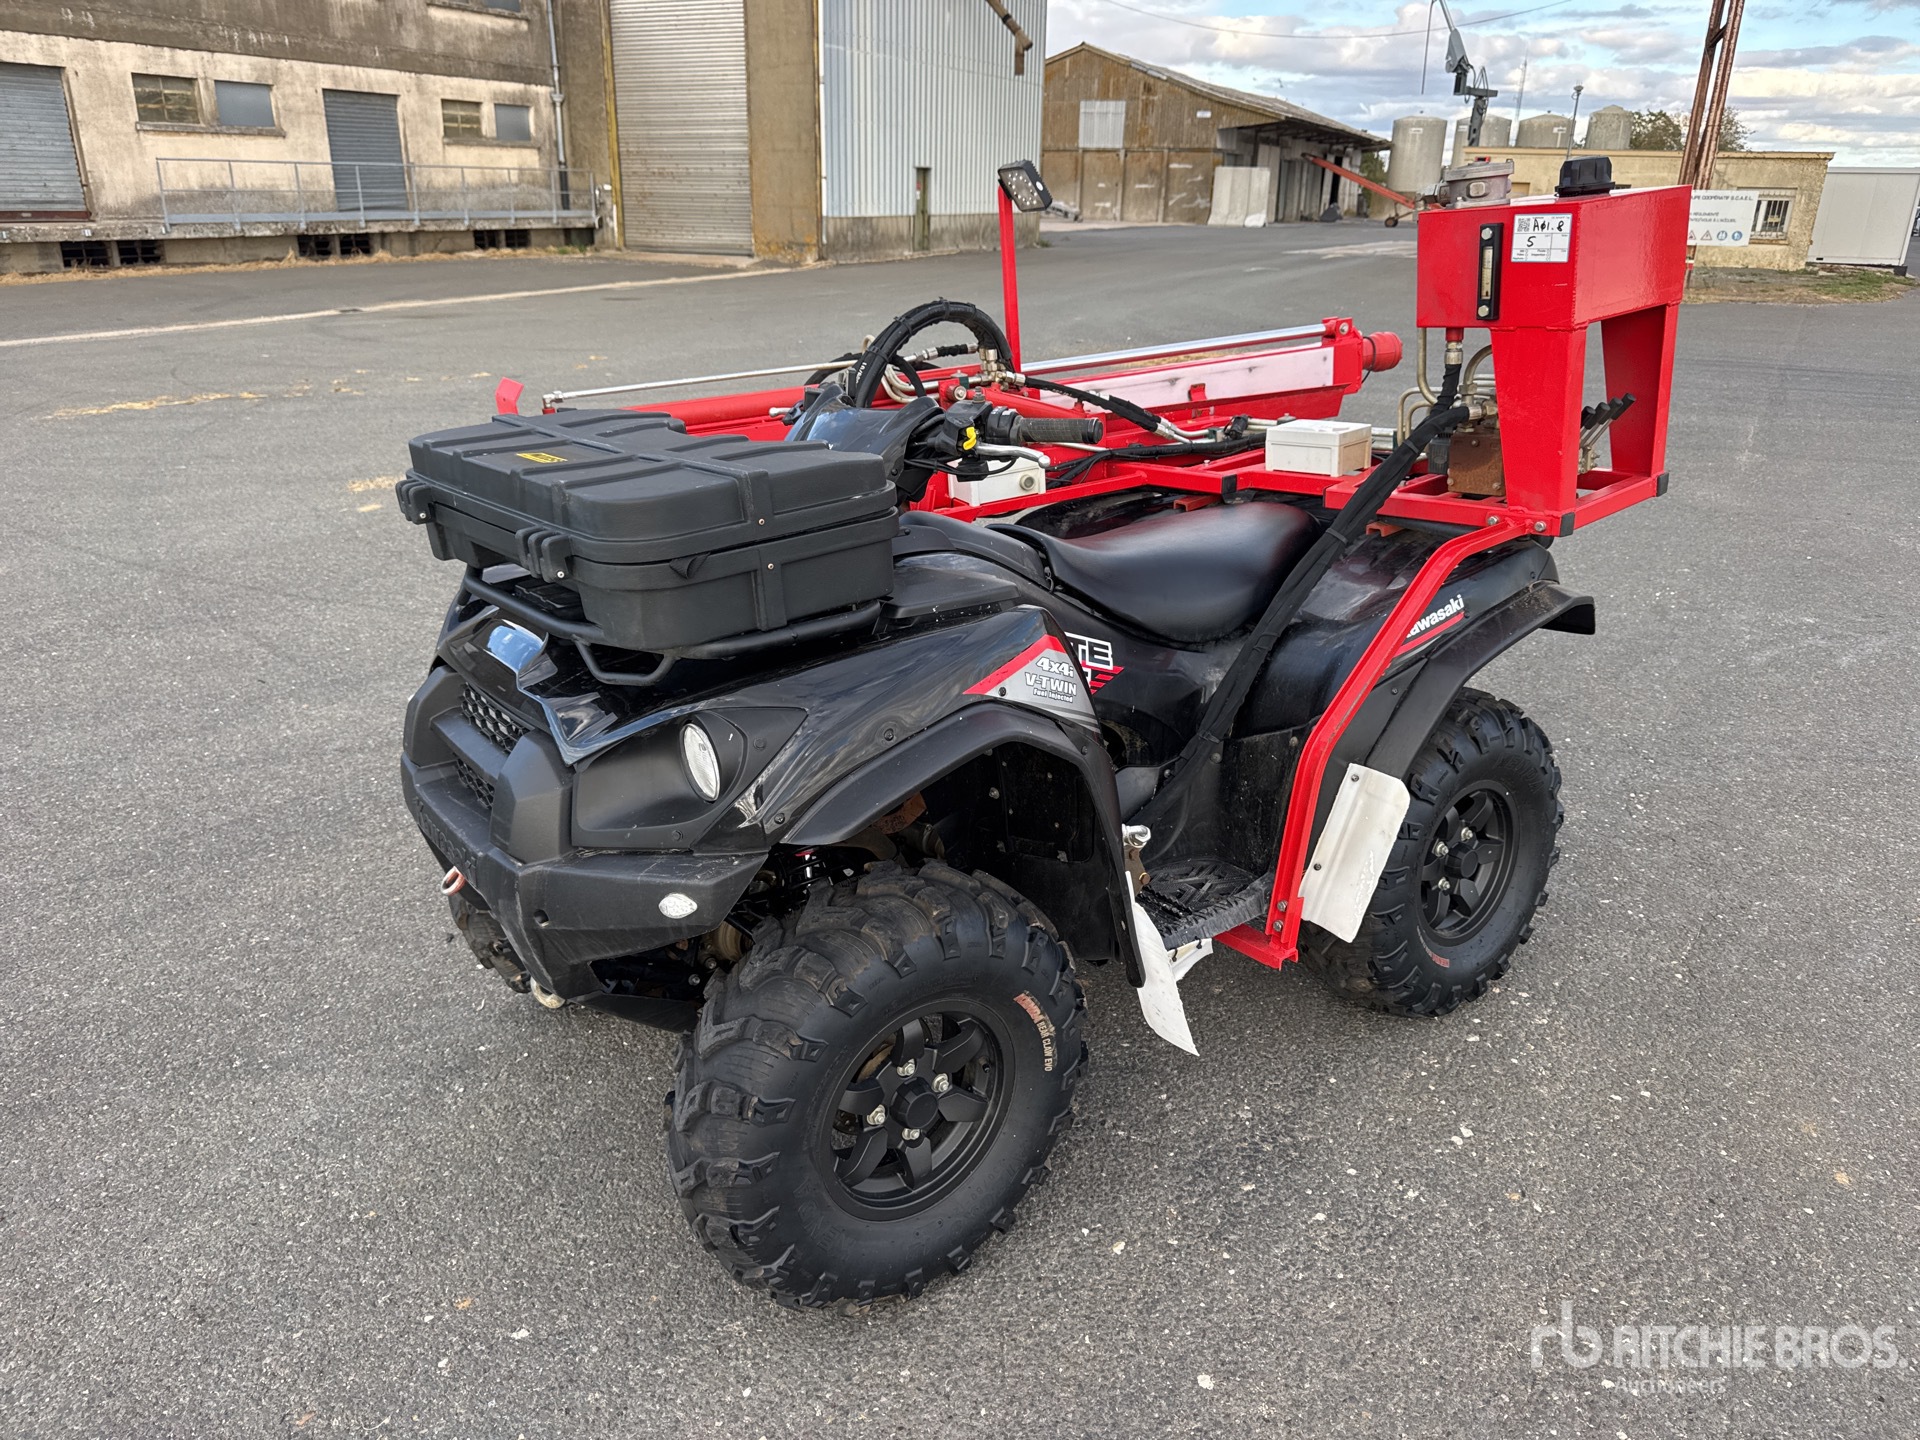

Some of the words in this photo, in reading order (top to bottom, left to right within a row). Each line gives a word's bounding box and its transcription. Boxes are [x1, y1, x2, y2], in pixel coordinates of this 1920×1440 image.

[1406, 594, 1465, 639] awasaki
[1036, 656, 1075, 678] 4x4i
[1025, 672, 1078, 697] V-TWIN
[1033, 687, 1048, 697] Fuel
[1036, 1020, 1050, 1039] BEAR
[1042, 1038, 1053, 1057] CLAW
[1044, 1058, 1053, 1072] EVO
